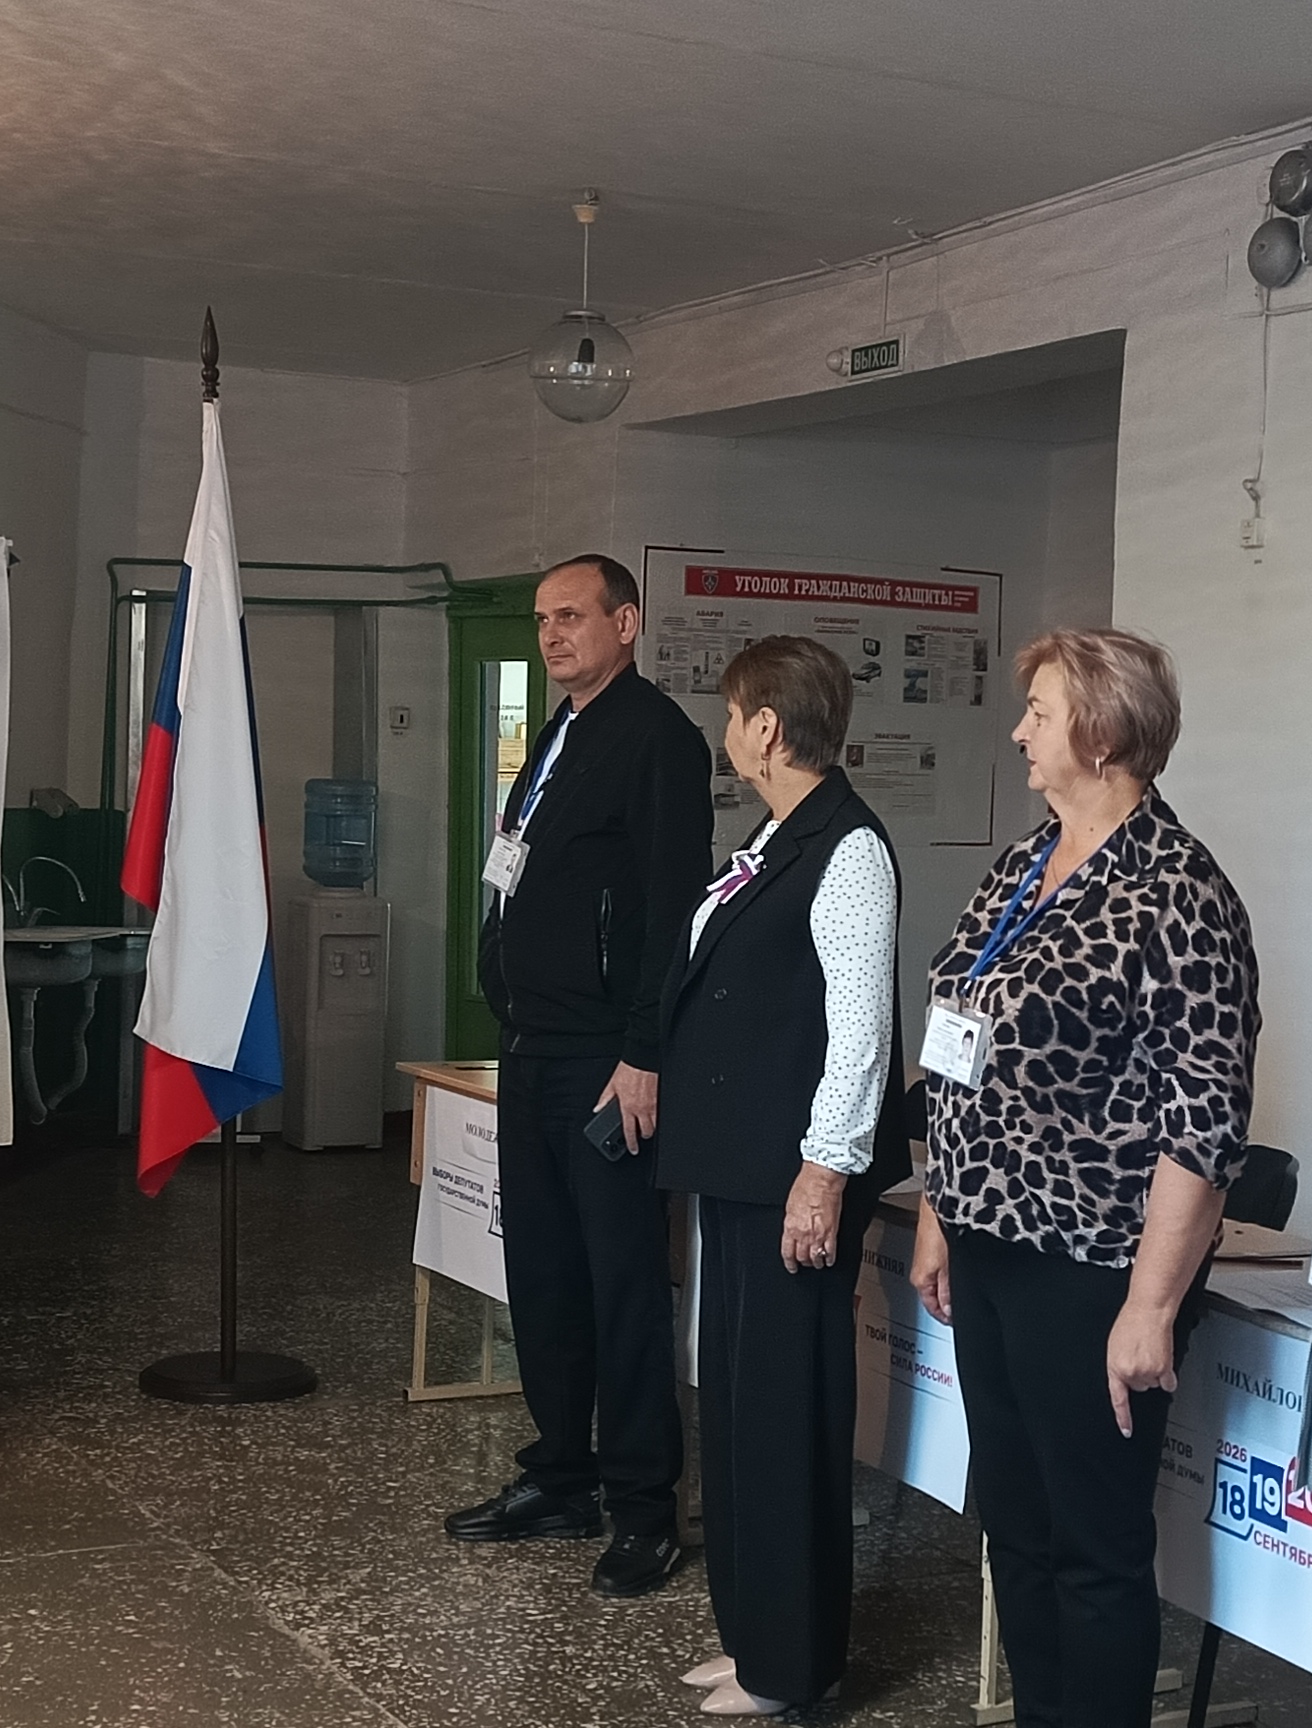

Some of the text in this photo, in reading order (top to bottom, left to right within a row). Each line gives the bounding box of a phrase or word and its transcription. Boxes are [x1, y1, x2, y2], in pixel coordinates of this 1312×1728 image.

[854, 344, 897, 371] ВЫХОД
[735, 575, 789, 594] УГОЛОК
[793, 579, 891, 601] ГРАЖДАНСКОЙ
[895, 586, 953, 607] ЗАЩИТЫ
[865, 1324, 887, 1344] ТВОЙ
[888, 1334, 916, 1355] ГОЛОС
[891, 1353, 953, 1387] СИЛА РОССИИ!
[1216, 1438, 1247, 1463] 2026
[1218, 1481, 1245, 1521] 18
[1252, 1473, 1281, 1516] 19
